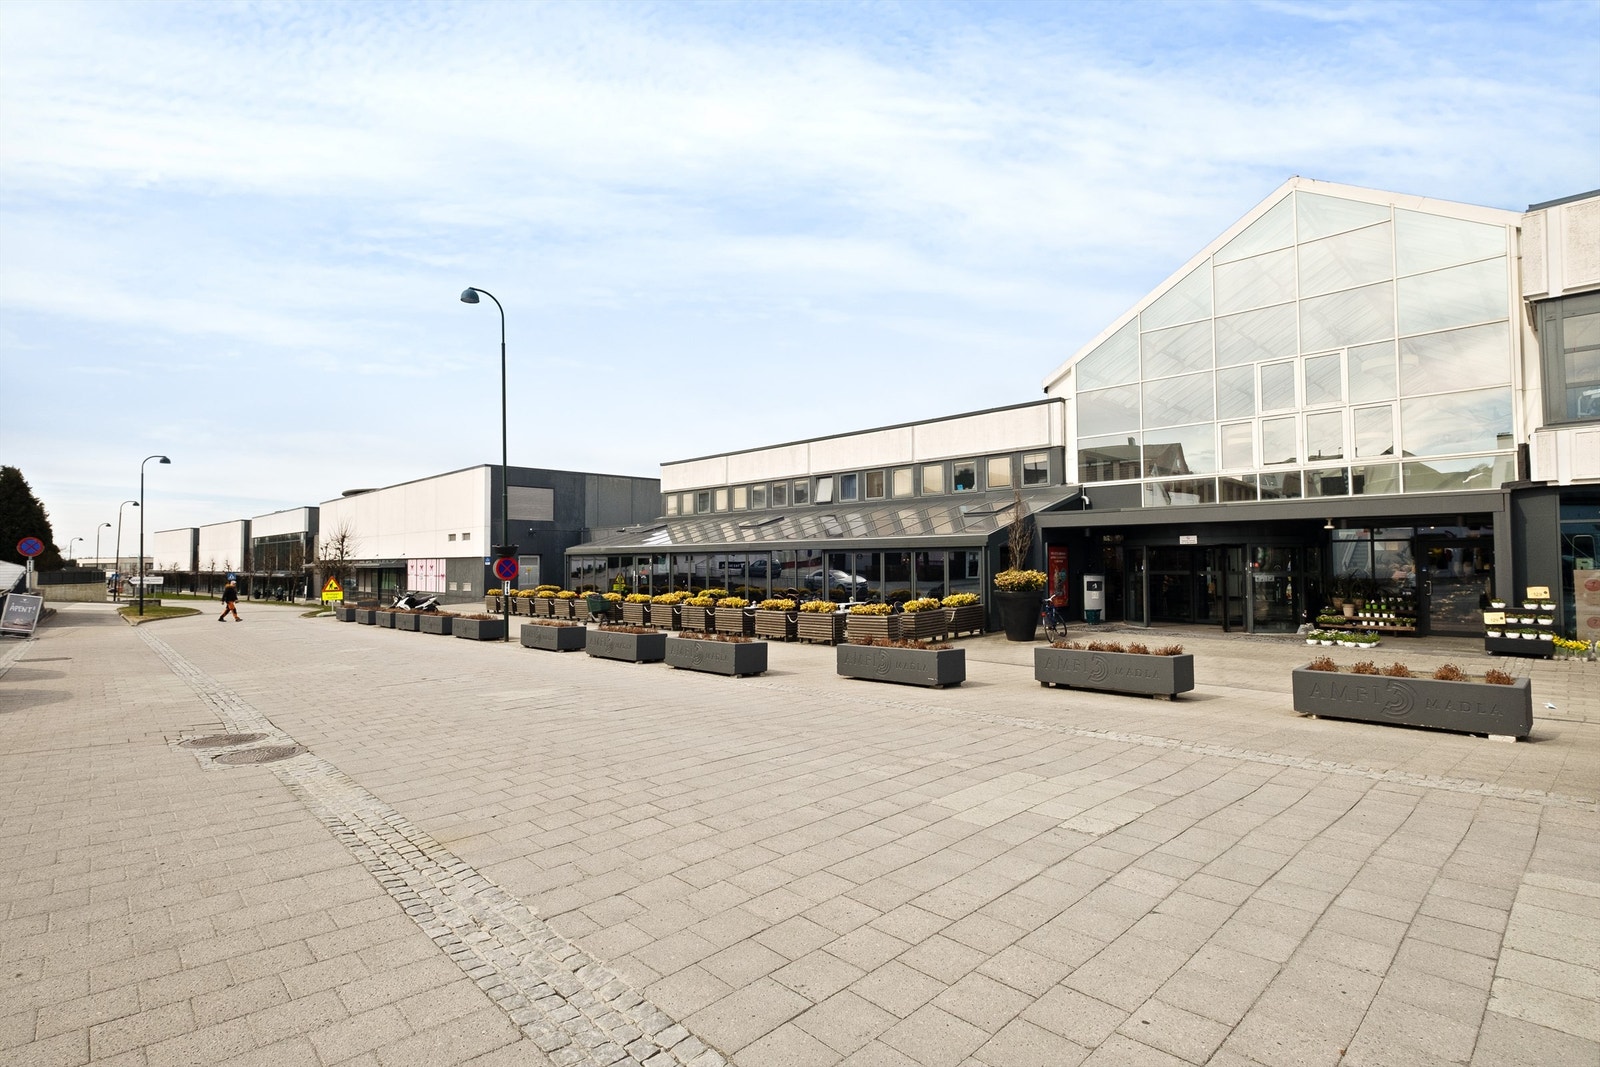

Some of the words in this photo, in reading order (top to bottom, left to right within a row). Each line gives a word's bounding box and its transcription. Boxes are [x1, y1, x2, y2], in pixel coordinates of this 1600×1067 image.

[843, 651, 877, 667] AMFI
[895, 660, 928, 673] MADLA
[1044, 656, 1088, 673] AMFI
[1114, 666, 1160, 680] MADLA
[1309, 681, 1383, 705] AMFI
[1425, 697, 1503, 717] MADLA
